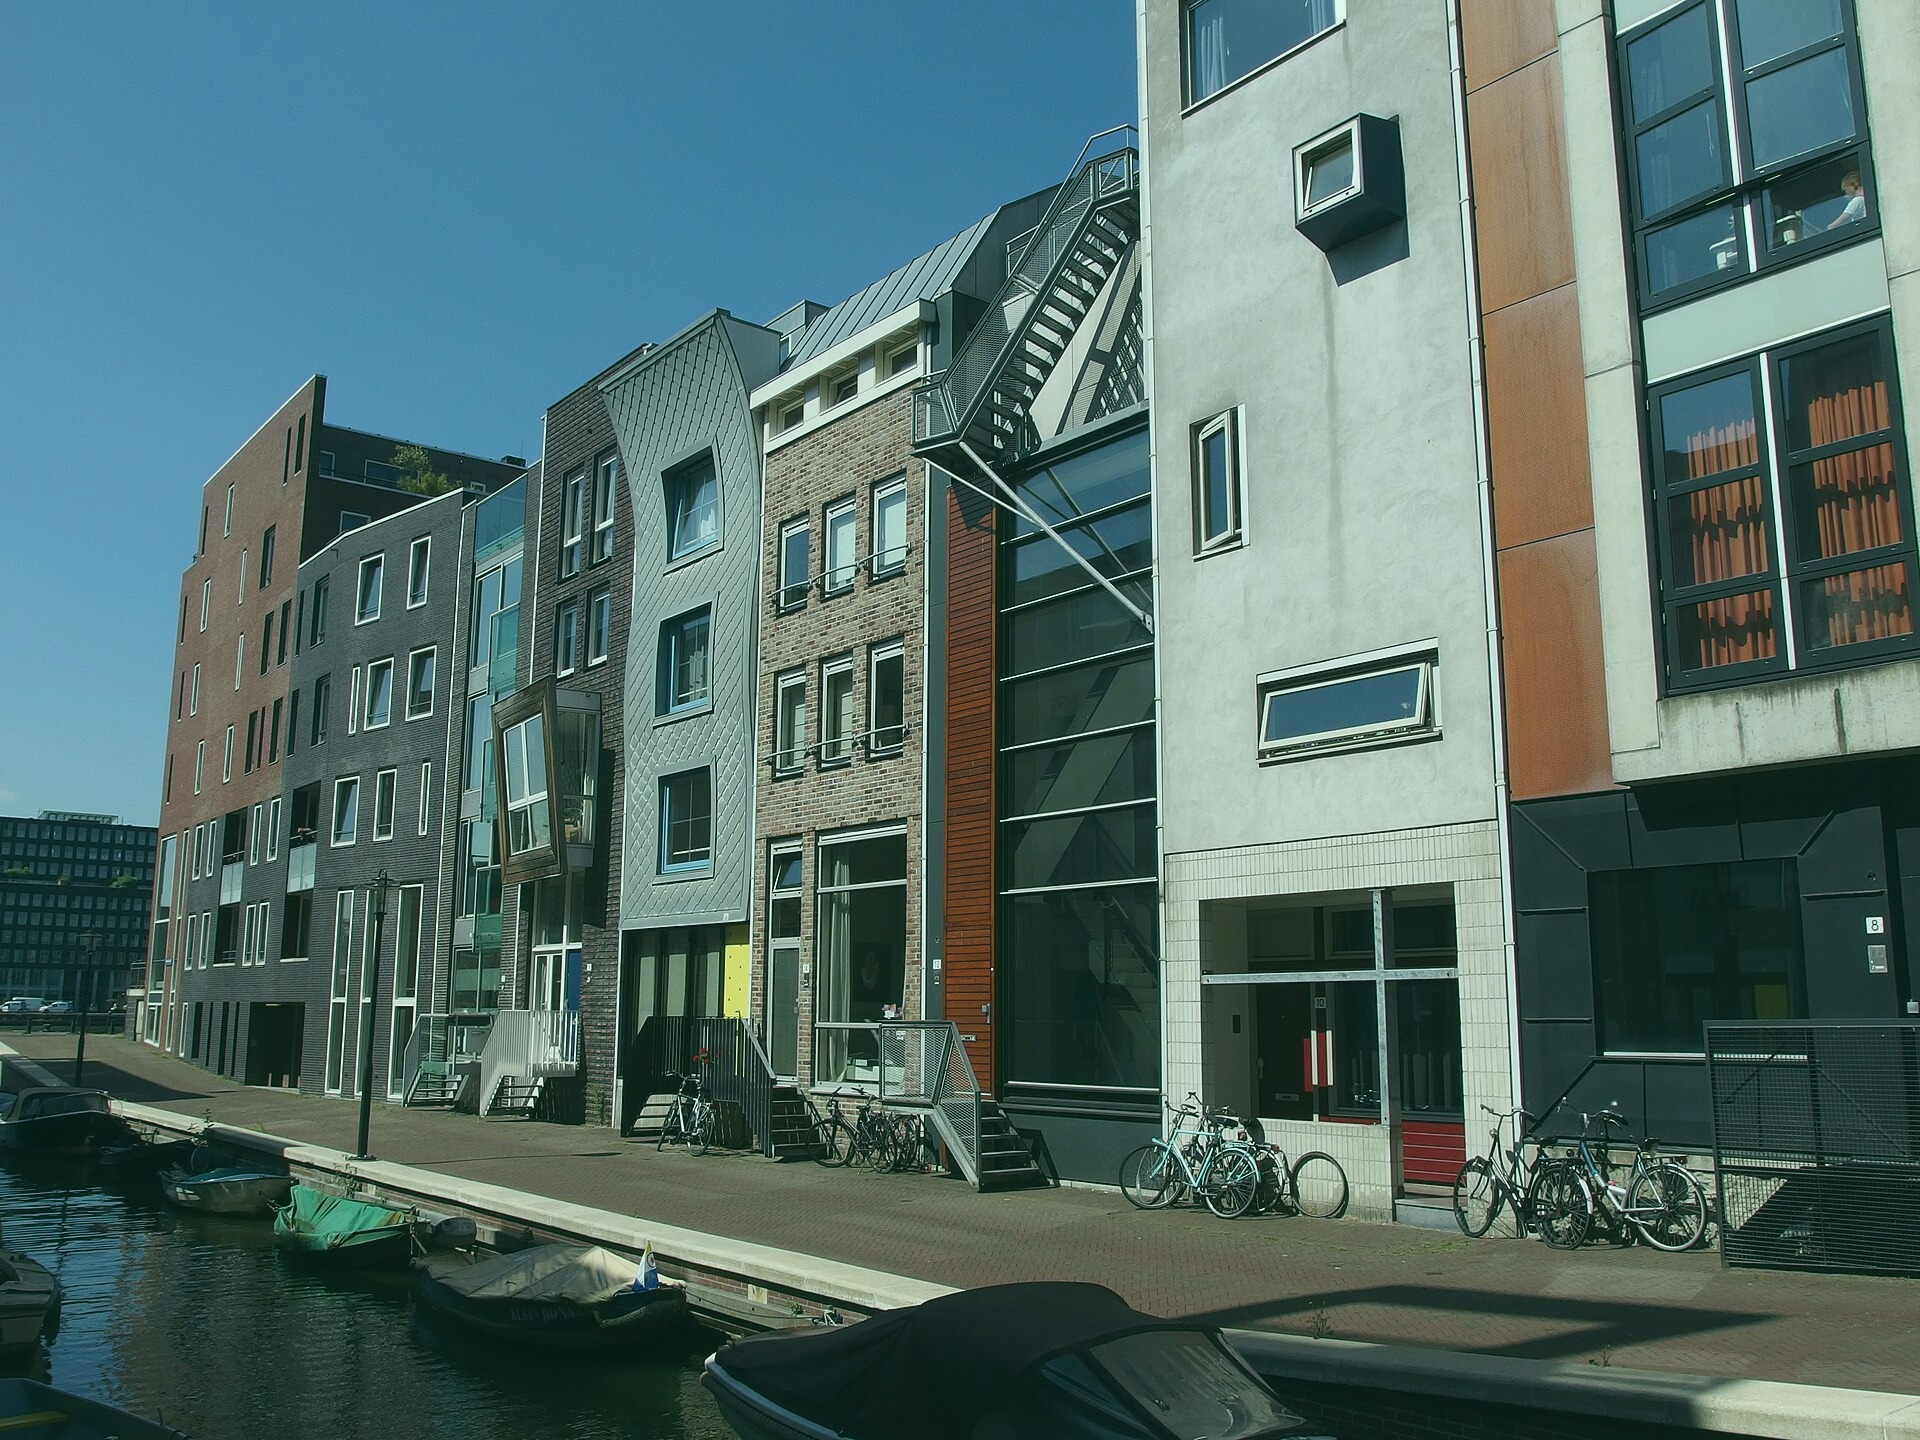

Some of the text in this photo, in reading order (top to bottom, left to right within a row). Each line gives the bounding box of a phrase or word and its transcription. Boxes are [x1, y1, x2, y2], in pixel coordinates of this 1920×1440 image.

[1871, 919, 1879, 931] 8
[934, 960, 940, 968] 12
[1316, 998, 1324, 1007] 10
